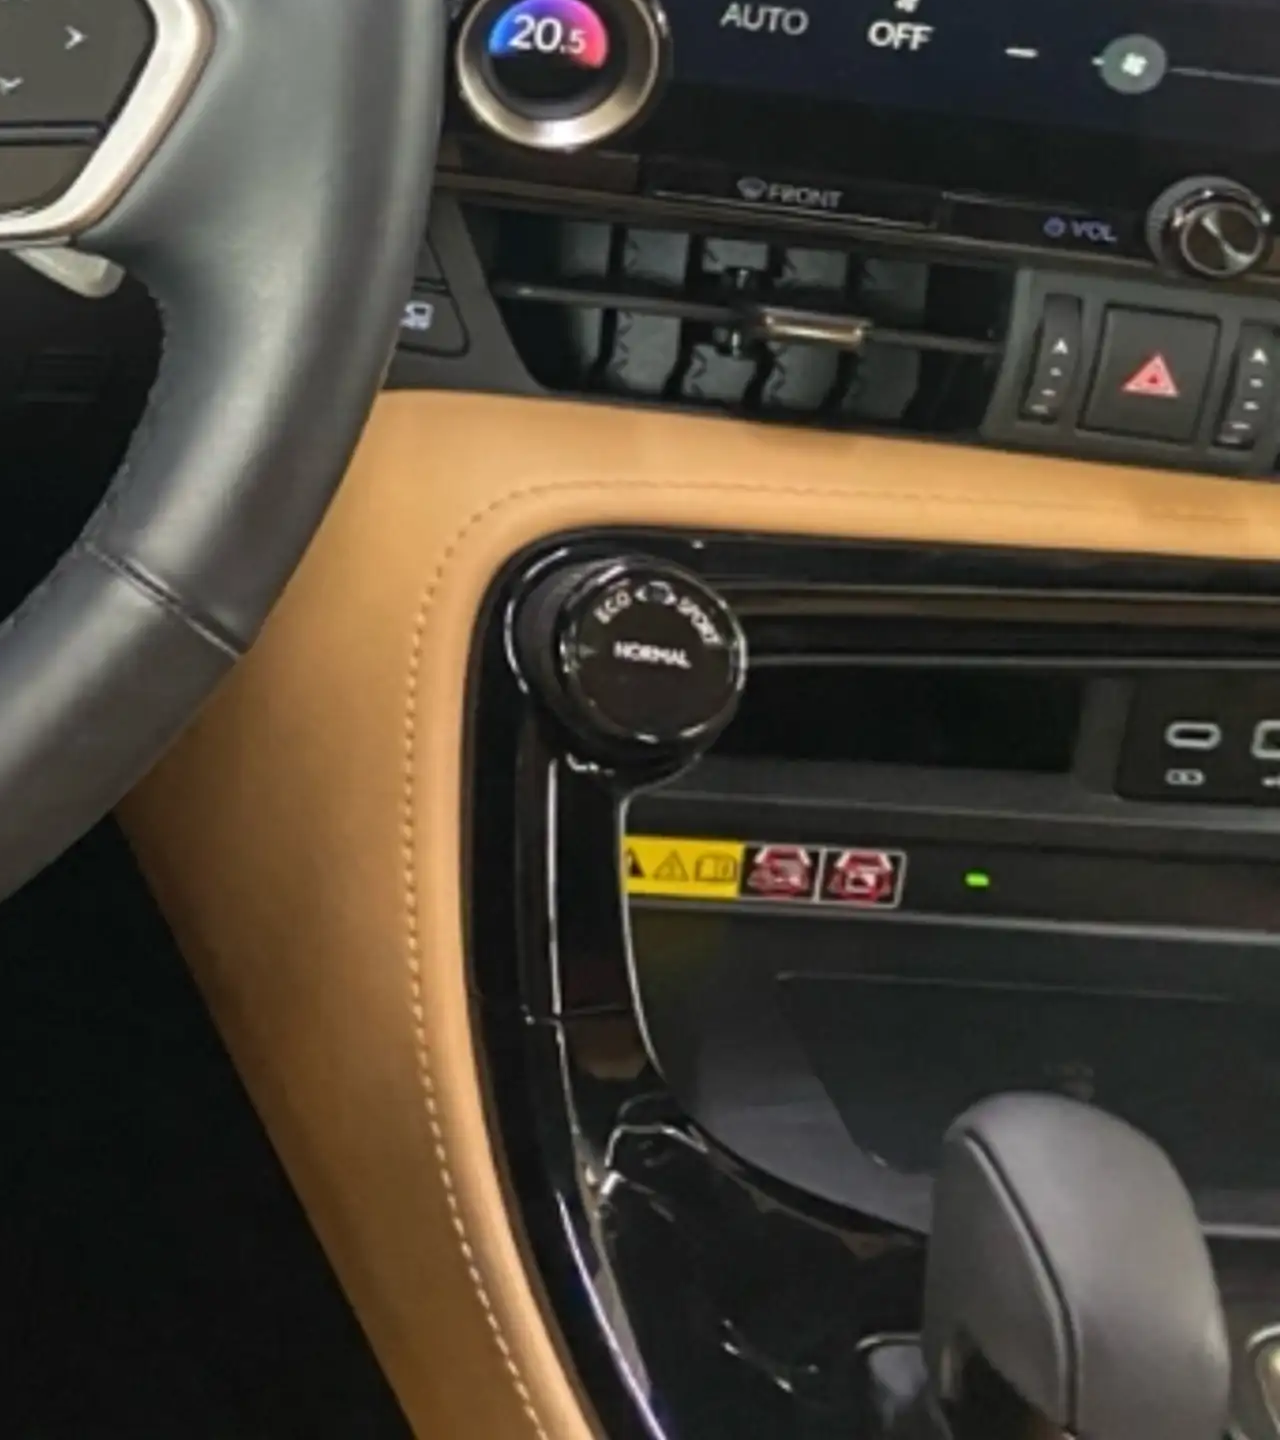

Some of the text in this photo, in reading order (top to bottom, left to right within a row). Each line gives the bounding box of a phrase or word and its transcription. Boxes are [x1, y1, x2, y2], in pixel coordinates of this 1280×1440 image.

[508, 13, 588, 56] 20.5
[719, 1, 810, 36] AUTO
[867, 19, 936, 52] OFF
[766, 182, 844, 211] FRONT
[1072, 221, 1119, 243] VOL
[592, 588, 632, 625] ECO
[676, 595, 722, 647] SPORT
[612, 640, 692, 670] NORMAL
